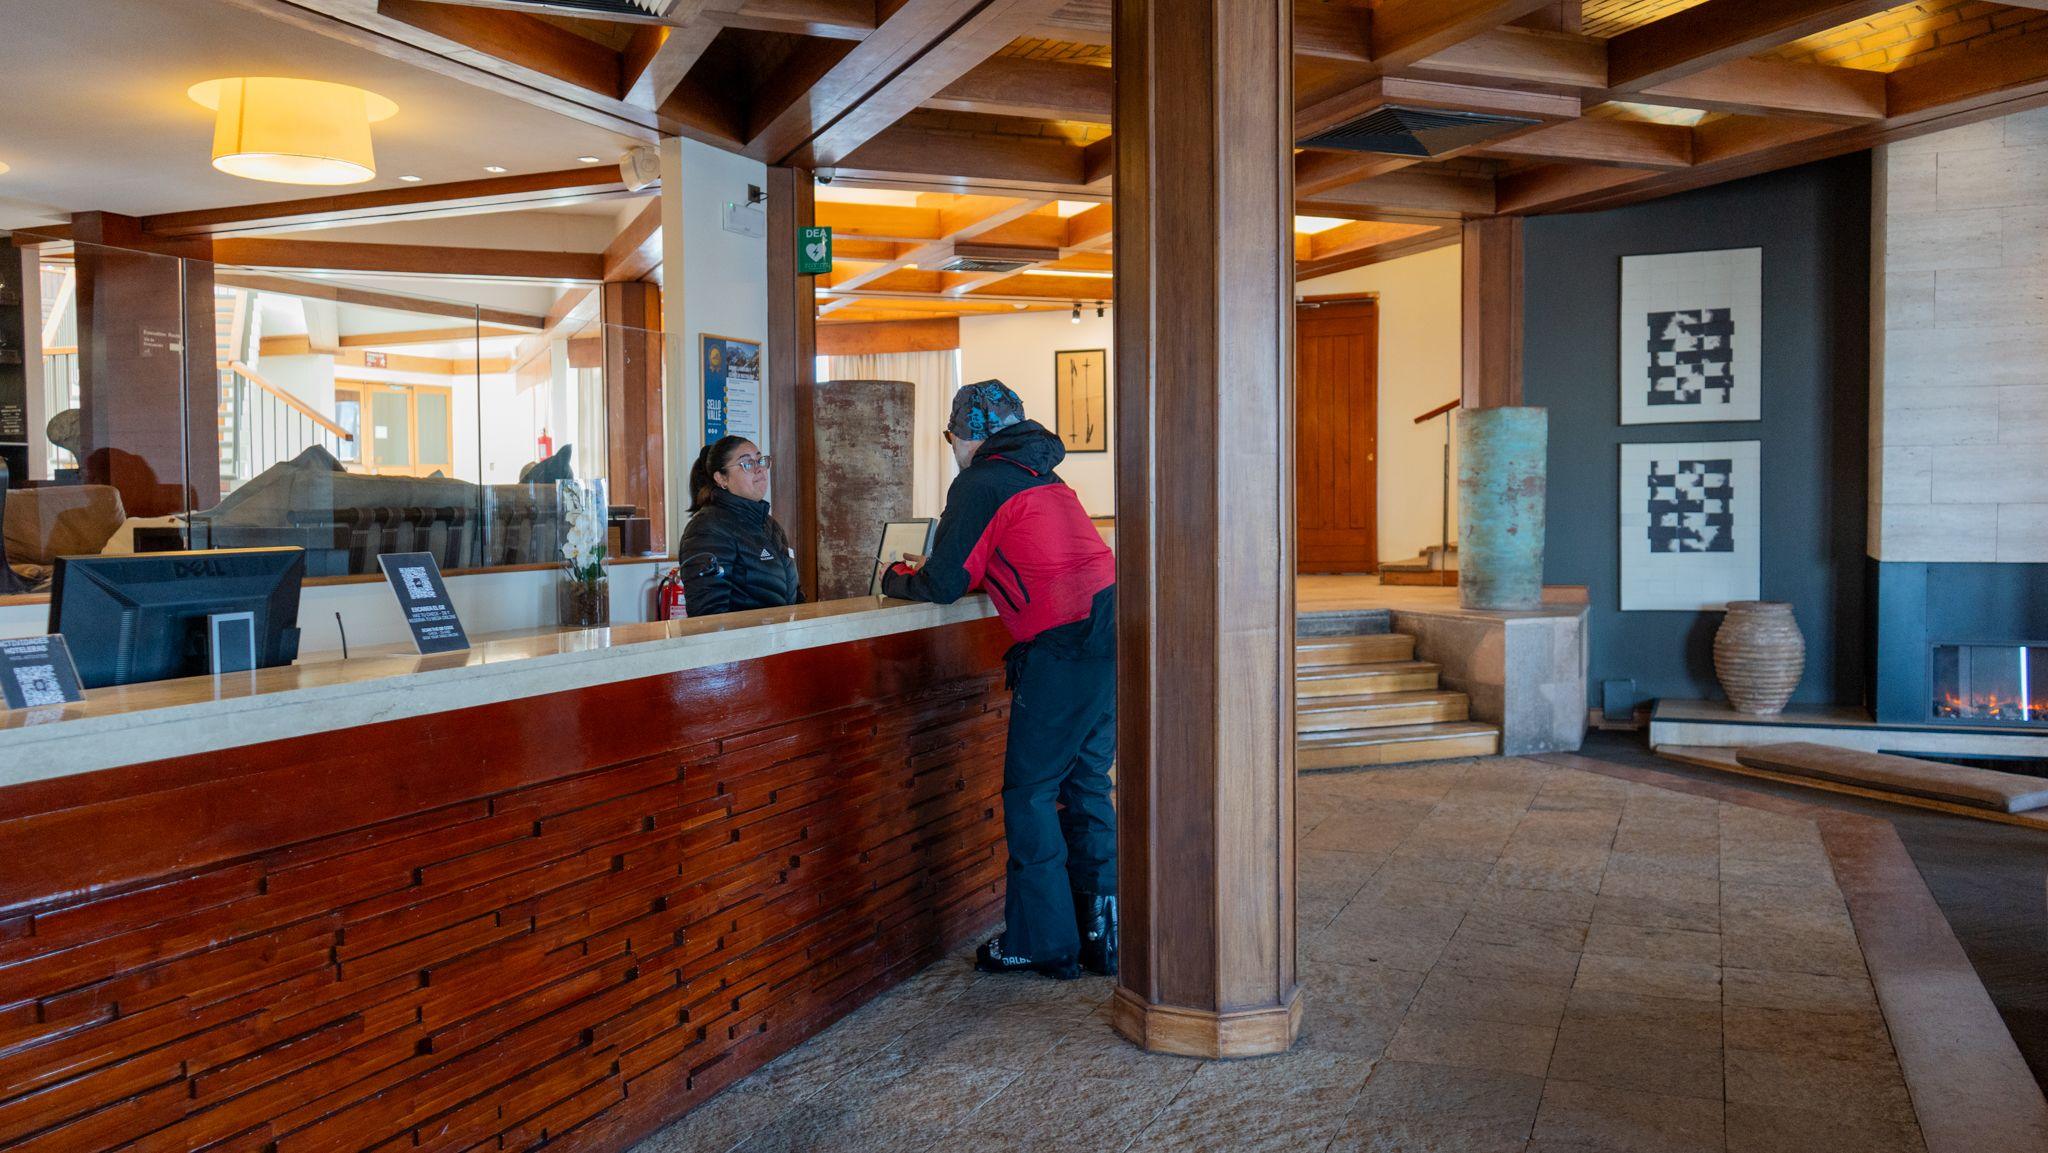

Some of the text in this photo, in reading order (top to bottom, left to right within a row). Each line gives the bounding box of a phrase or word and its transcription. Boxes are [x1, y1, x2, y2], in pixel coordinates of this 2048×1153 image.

[806, 228, 827, 238] DEA
[706, 398, 721, 410] SELLO
[707, 409, 721, 421] VALLE
[174, 559, 226, 578] DELL
